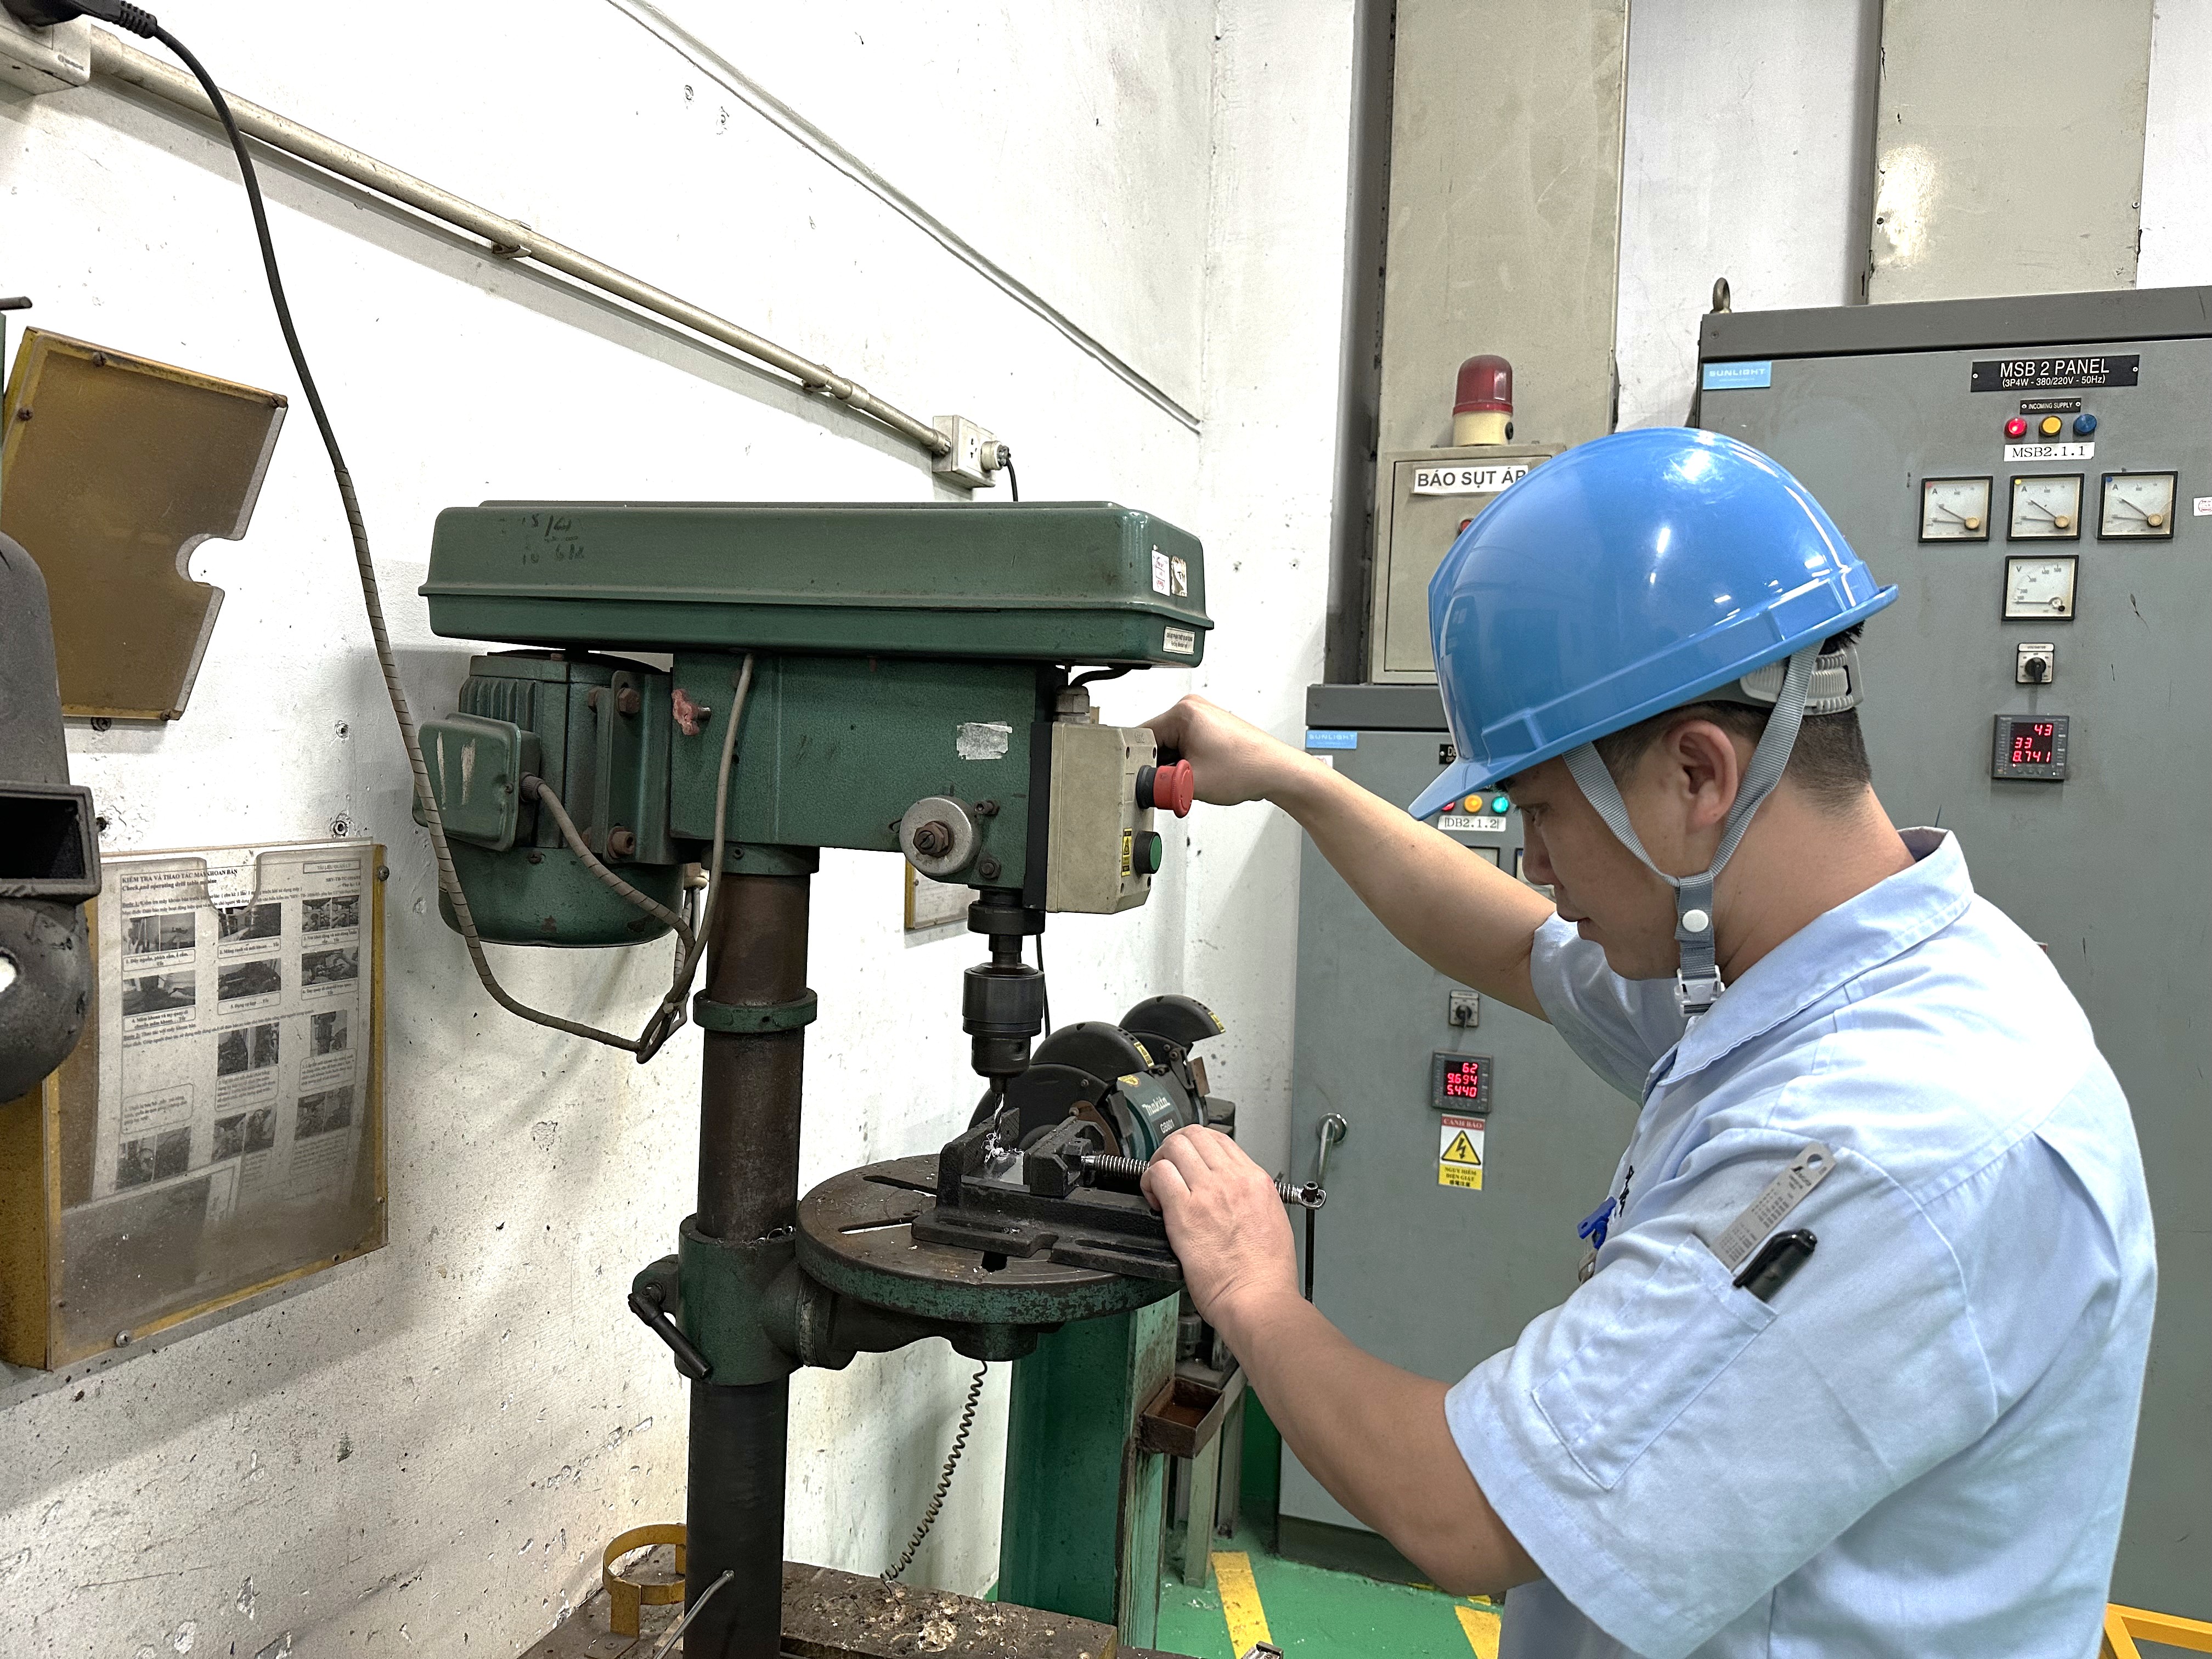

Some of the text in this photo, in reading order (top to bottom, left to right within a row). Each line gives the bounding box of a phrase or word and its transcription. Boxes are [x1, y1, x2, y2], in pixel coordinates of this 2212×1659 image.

[1709, 368, 1766, 377] SUNLIGHT
[2000, 358, 2109, 378] MSB 2 PANEL
[2002, 379, 2029, 388] (3P4W
[2036, 376, 2074, 386] 380/220V
[2081, 374, 2106, 384] 50Hz)
[2012, 445, 2085, 458] MSB2.1.1
[1418, 467, 1526, 488] BÁO SỤT ÁP
[2034, 724, 2052, 736] 43
[2015, 737, 2033, 748] 33
[1462, 1062, 1478, 1074] 62
